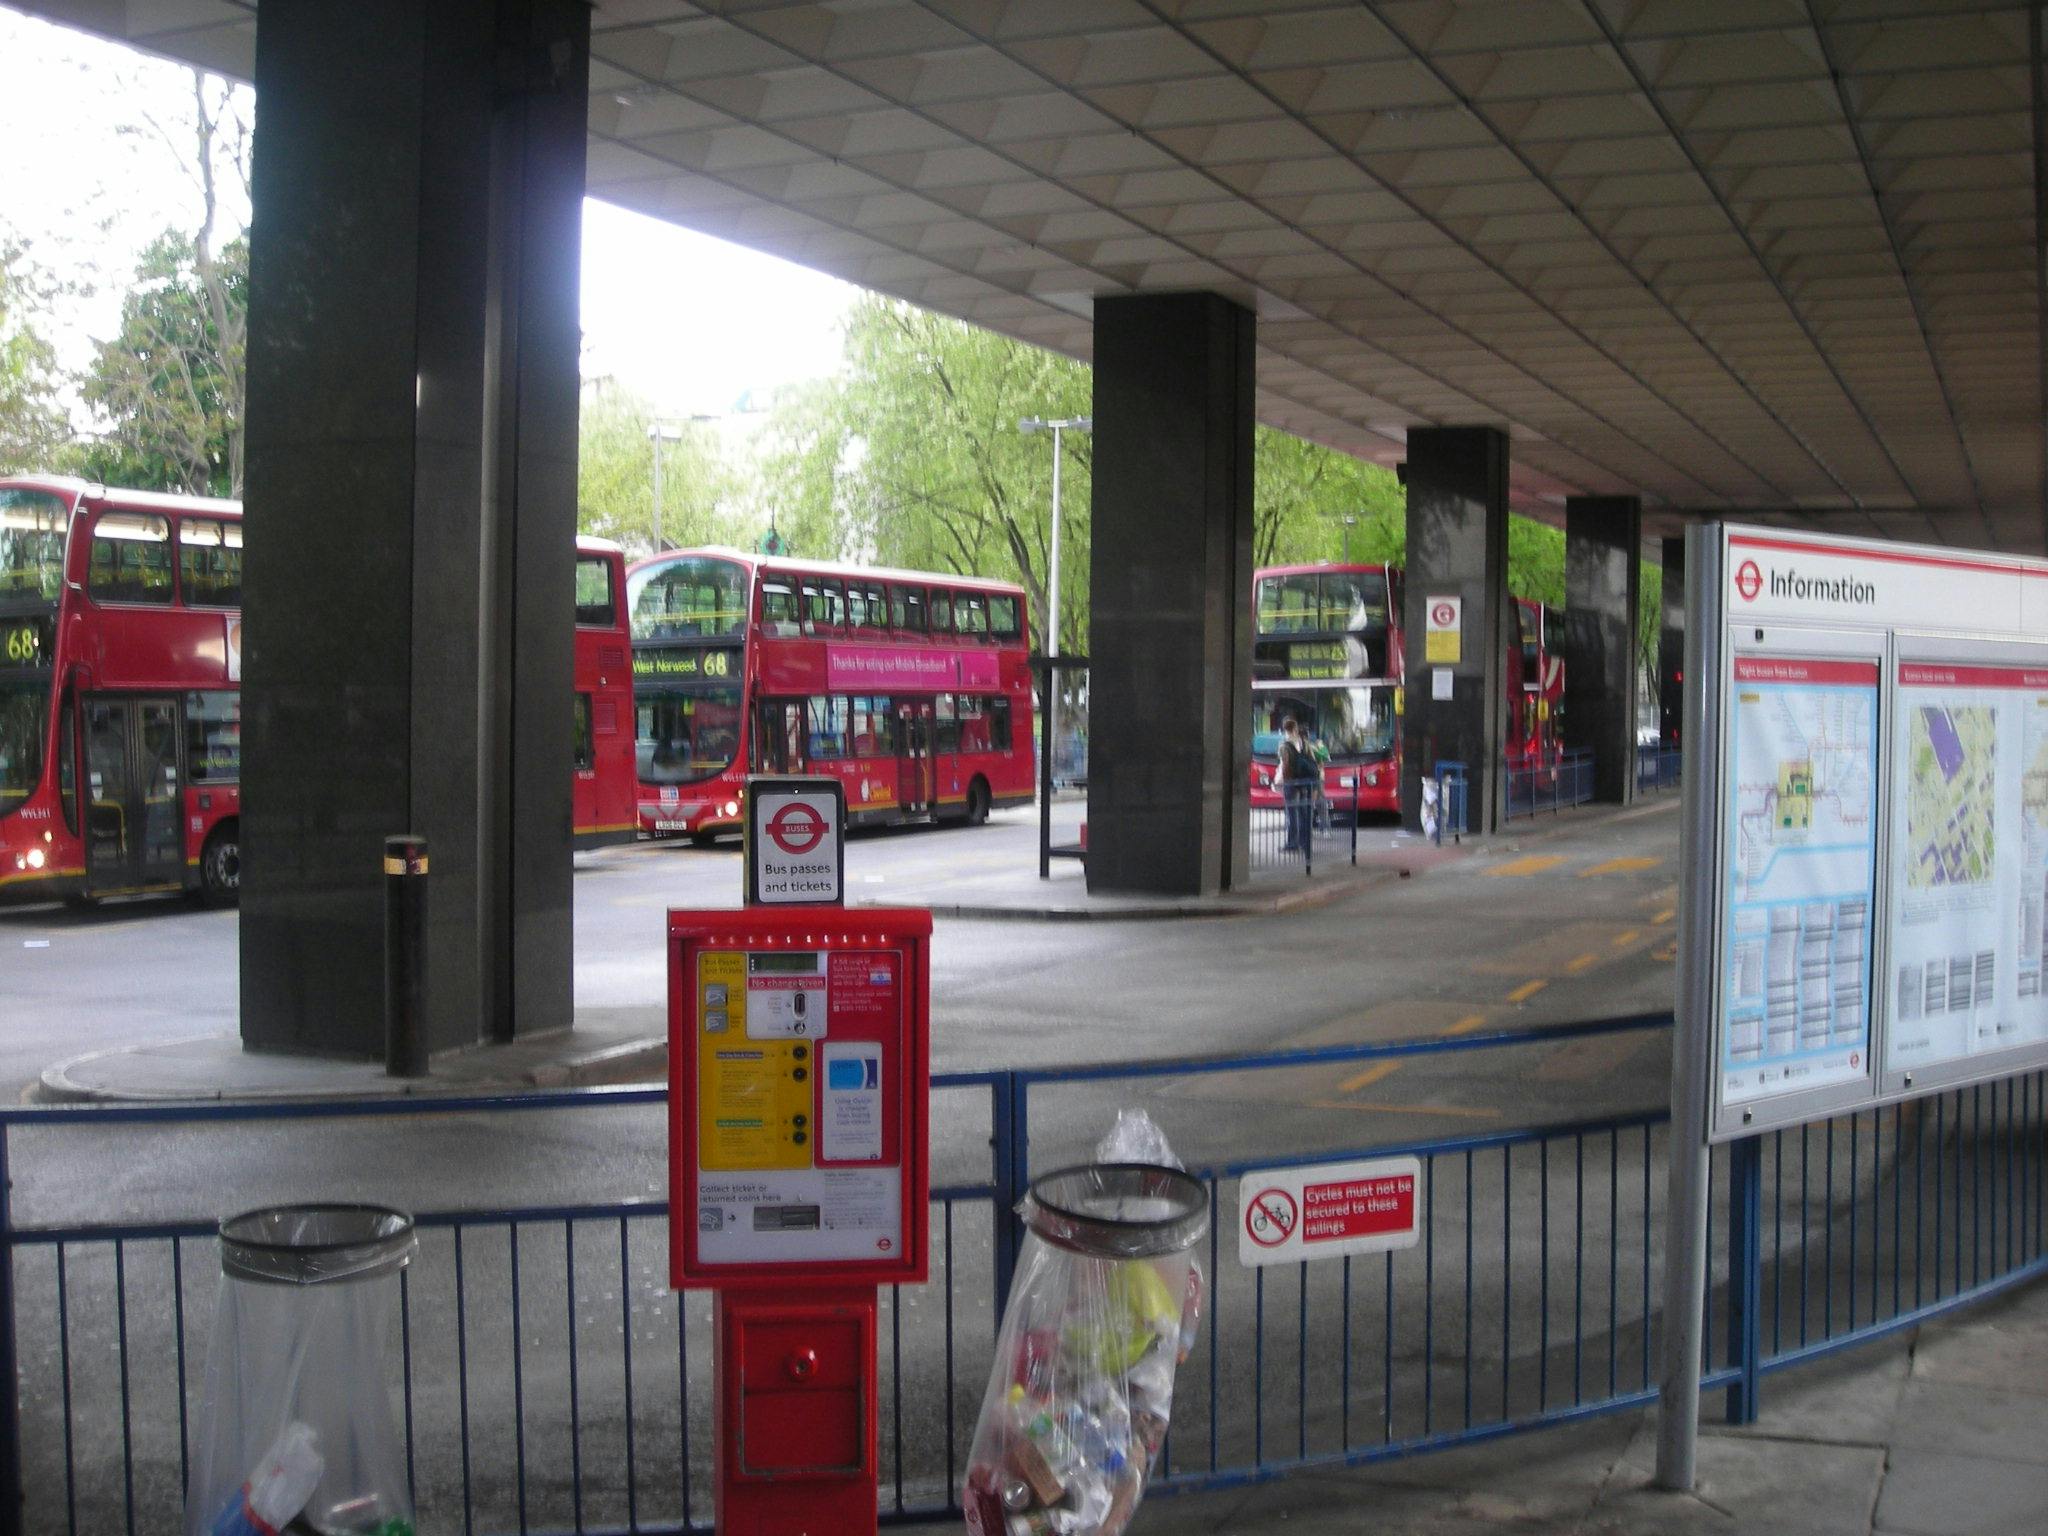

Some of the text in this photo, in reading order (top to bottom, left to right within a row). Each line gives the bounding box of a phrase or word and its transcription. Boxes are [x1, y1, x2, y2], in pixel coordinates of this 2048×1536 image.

[1770, 566, 1876, 605] Information
[8, 628, 33, 660] 68
[632, 652, 727, 676] West Norwood 68
[765, 864, 831, 876] Bus passes
[765, 881, 832, 892] and tickets
[752, 979, 765, 987] No
[700, 1185, 730, 1193] Collect
[732, 1185, 756, 1193] ticket
[1306, 1179, 1412, 1204] Cycles must not be
[1306, 1198, 1399, 1219] secured to these
[1306, 1220, 1346, 1236] railings
